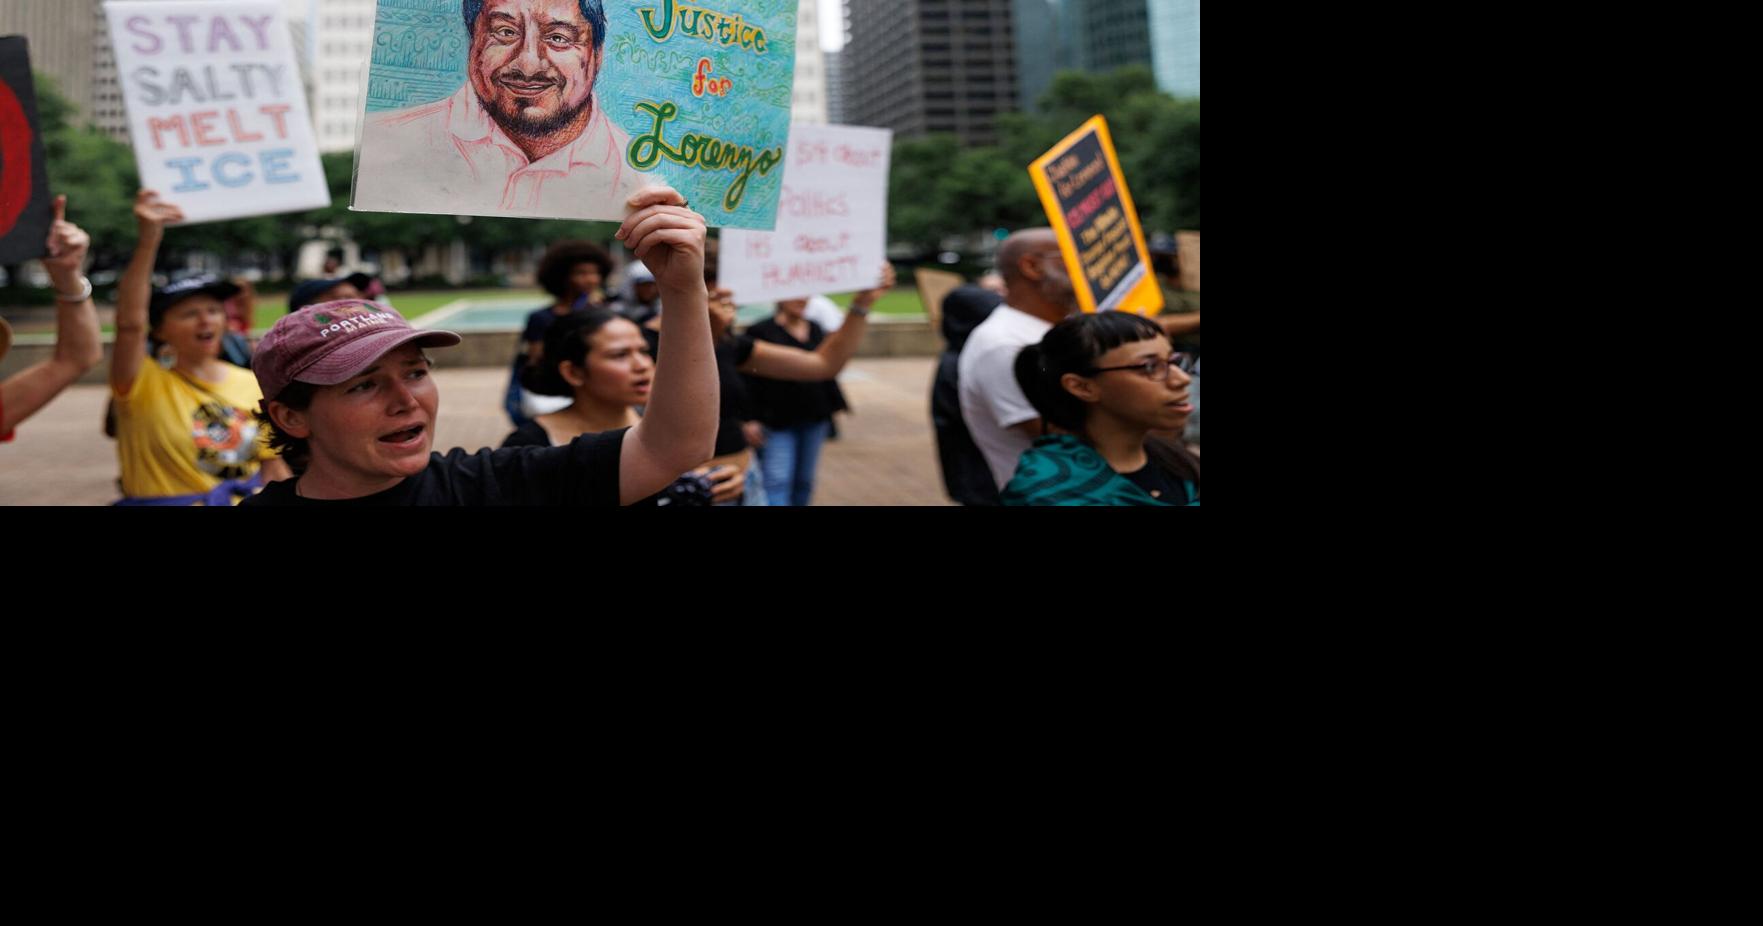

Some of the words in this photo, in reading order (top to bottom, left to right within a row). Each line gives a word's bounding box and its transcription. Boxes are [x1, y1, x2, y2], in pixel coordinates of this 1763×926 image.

[126, 15, 273, 55] STAY
[638, 0, 768, 53] Justice
[131, 63, 285, 106] SALTY
[692, 57, 732, 97] for
[147, 103, 291, 150] MELT
[164, 148, 302, 193] ICE
[627, 99, 782, 213] Lorenzo
